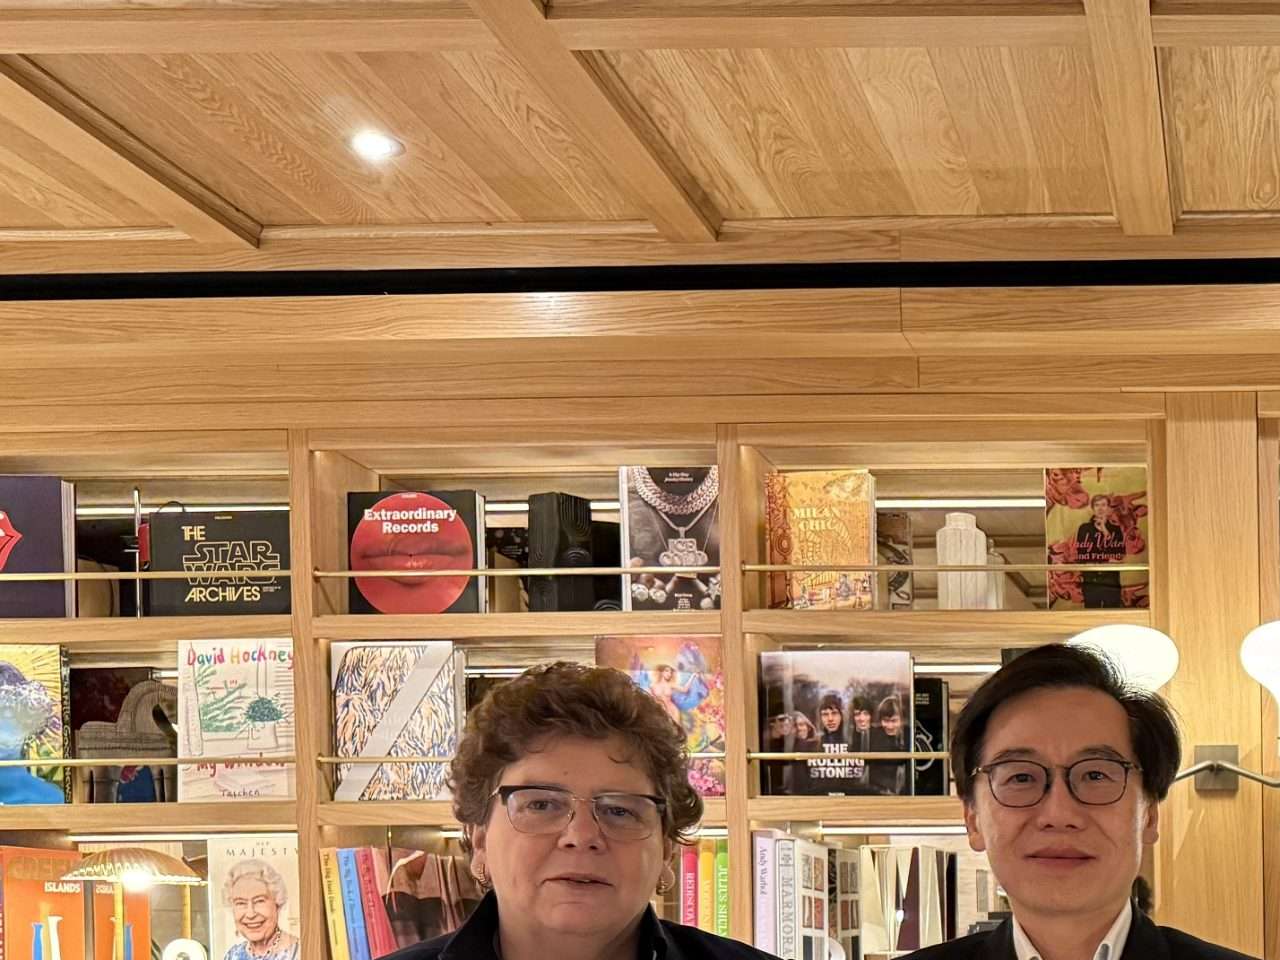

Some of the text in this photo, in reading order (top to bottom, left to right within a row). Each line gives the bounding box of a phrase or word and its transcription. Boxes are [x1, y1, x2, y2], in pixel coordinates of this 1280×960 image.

[363, 506, 457, 521] Extraordinary
[181, 525, 206, 541] THE
[382, 521, 439, 534] Records
[183, 541, 280, 563] STAR
[183, 563, 280, 585] WARS
[184, 586, 261, 602] ARCHIVES
[187, 645, 294, 670] David Hockney
[822, 743, 849, 754] THE
[810, 767, 864, 778] STONES
[44, 882, 81, 893] ISLANDS
